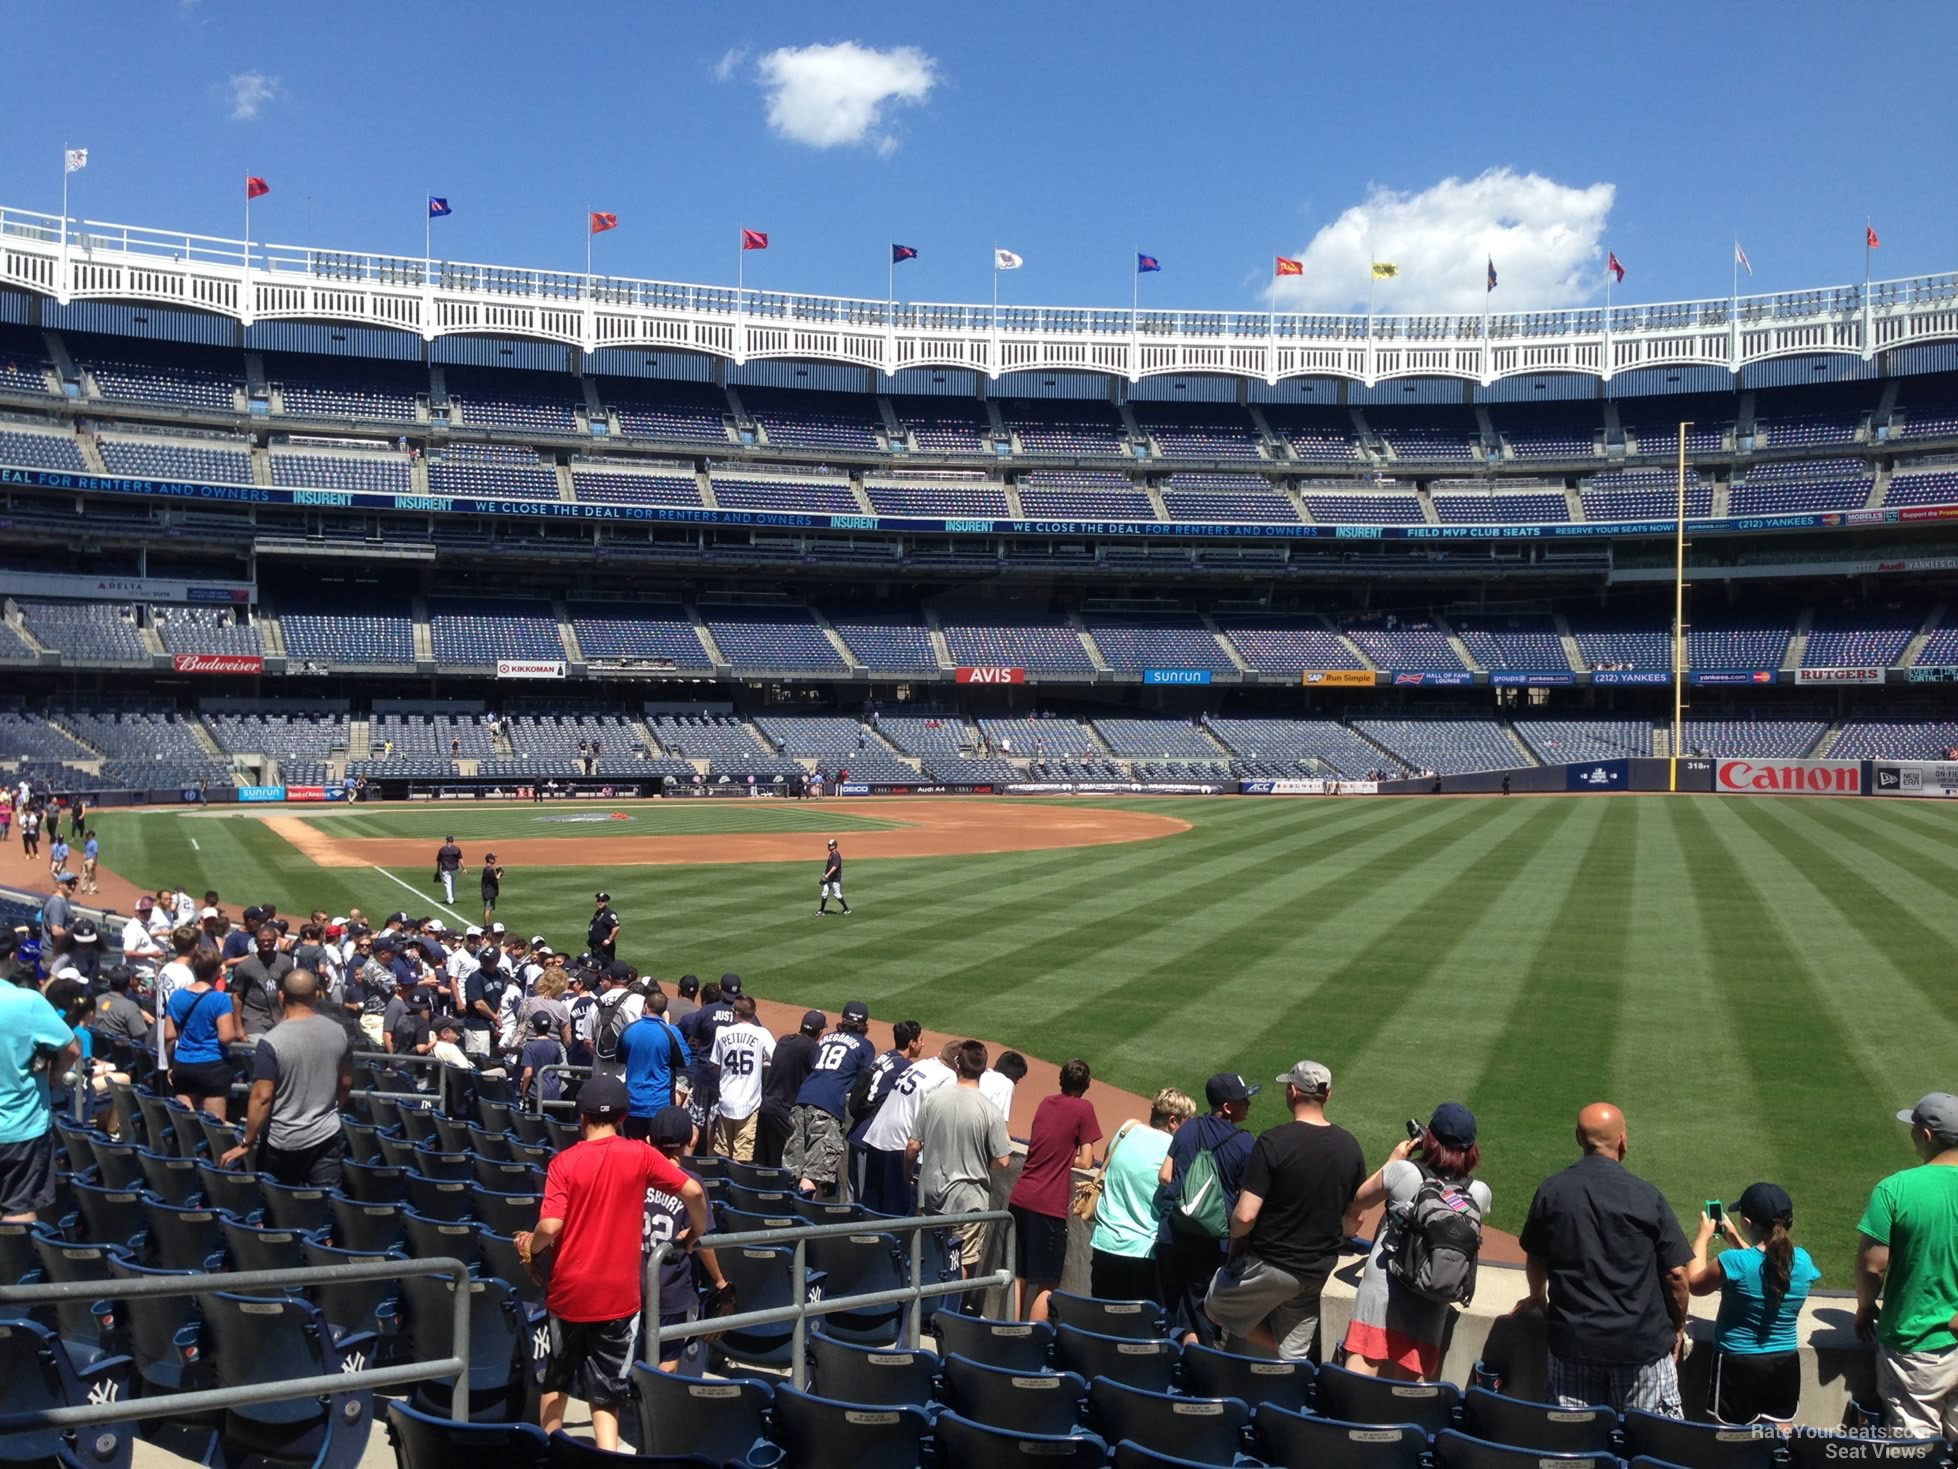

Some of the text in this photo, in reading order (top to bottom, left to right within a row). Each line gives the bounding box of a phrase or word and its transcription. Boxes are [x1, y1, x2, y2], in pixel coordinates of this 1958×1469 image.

[2, 471, 269, 501] EAL FOR RENTERS AND OWNERS
[293, 490, 353, 506] INSURENT
[395, 496, 453, 511] INSURENT
[475, 501, 812, 526] WE CLOSE THE DEAL FOR RENTERS AND OWNERS
[1848, 512, 1883, 520] MODELL'S
[831, 516, 879, 529] INSURENT
[945, 520, 994, 532] INSURENT
[1555, 523, 1674, 534] RESERVE YOUR SEATS NOW!
[1738, 519, 1764, 529] (212)
[1766, 517, 1814, 526] YANKEES
[1013, 522, 1318, 536] WE CLOSE THE DEAL FOR RENTERS AND OWNERS
[1335, 527, 1383, 538] INSURENT
[1407, 527, 1540, 538] FIELD MVP CLUB SEATS
[1878, 561, 1905, 570] Audi
[1908, 560, 1945, 569] YANKEES
[108, 580, 143, 590] DELTA
[176, 655, 260, 671] Budweiser
[511, 665, 554, 674] KIKKOMAN
[969, 668, 1012, 682] AVIS
[1800, 669, 1878, 680] RUTGERS
[1908, 668, 1933, 676] EVERY
[1154, 670, 1201, 682] sunrun
[1307, 673, 1322, 683] SAP
[1343, 675, 1370, 683] Simple
[1493, 675, 1526, 683] groups@
[1595, 674, 1666, 683] (212) YANKEES
[1699, 674, 1746, 682] yankees.com
[1719, 761, 1858, 791] Canon
[243, 787, 280, 796] sunrun
[1246, 783, 1271, 792] ACC
[721, 1032, 759, 1048] PETTITTE
[724, 1049, 755, 1076] 46
[814, 1044, 848, 1070] 18
[895, 1067, 927, 1096] 25
[643, 1187, 684, 1216] SBURY
[532, 1325, 551, 1360] NY
